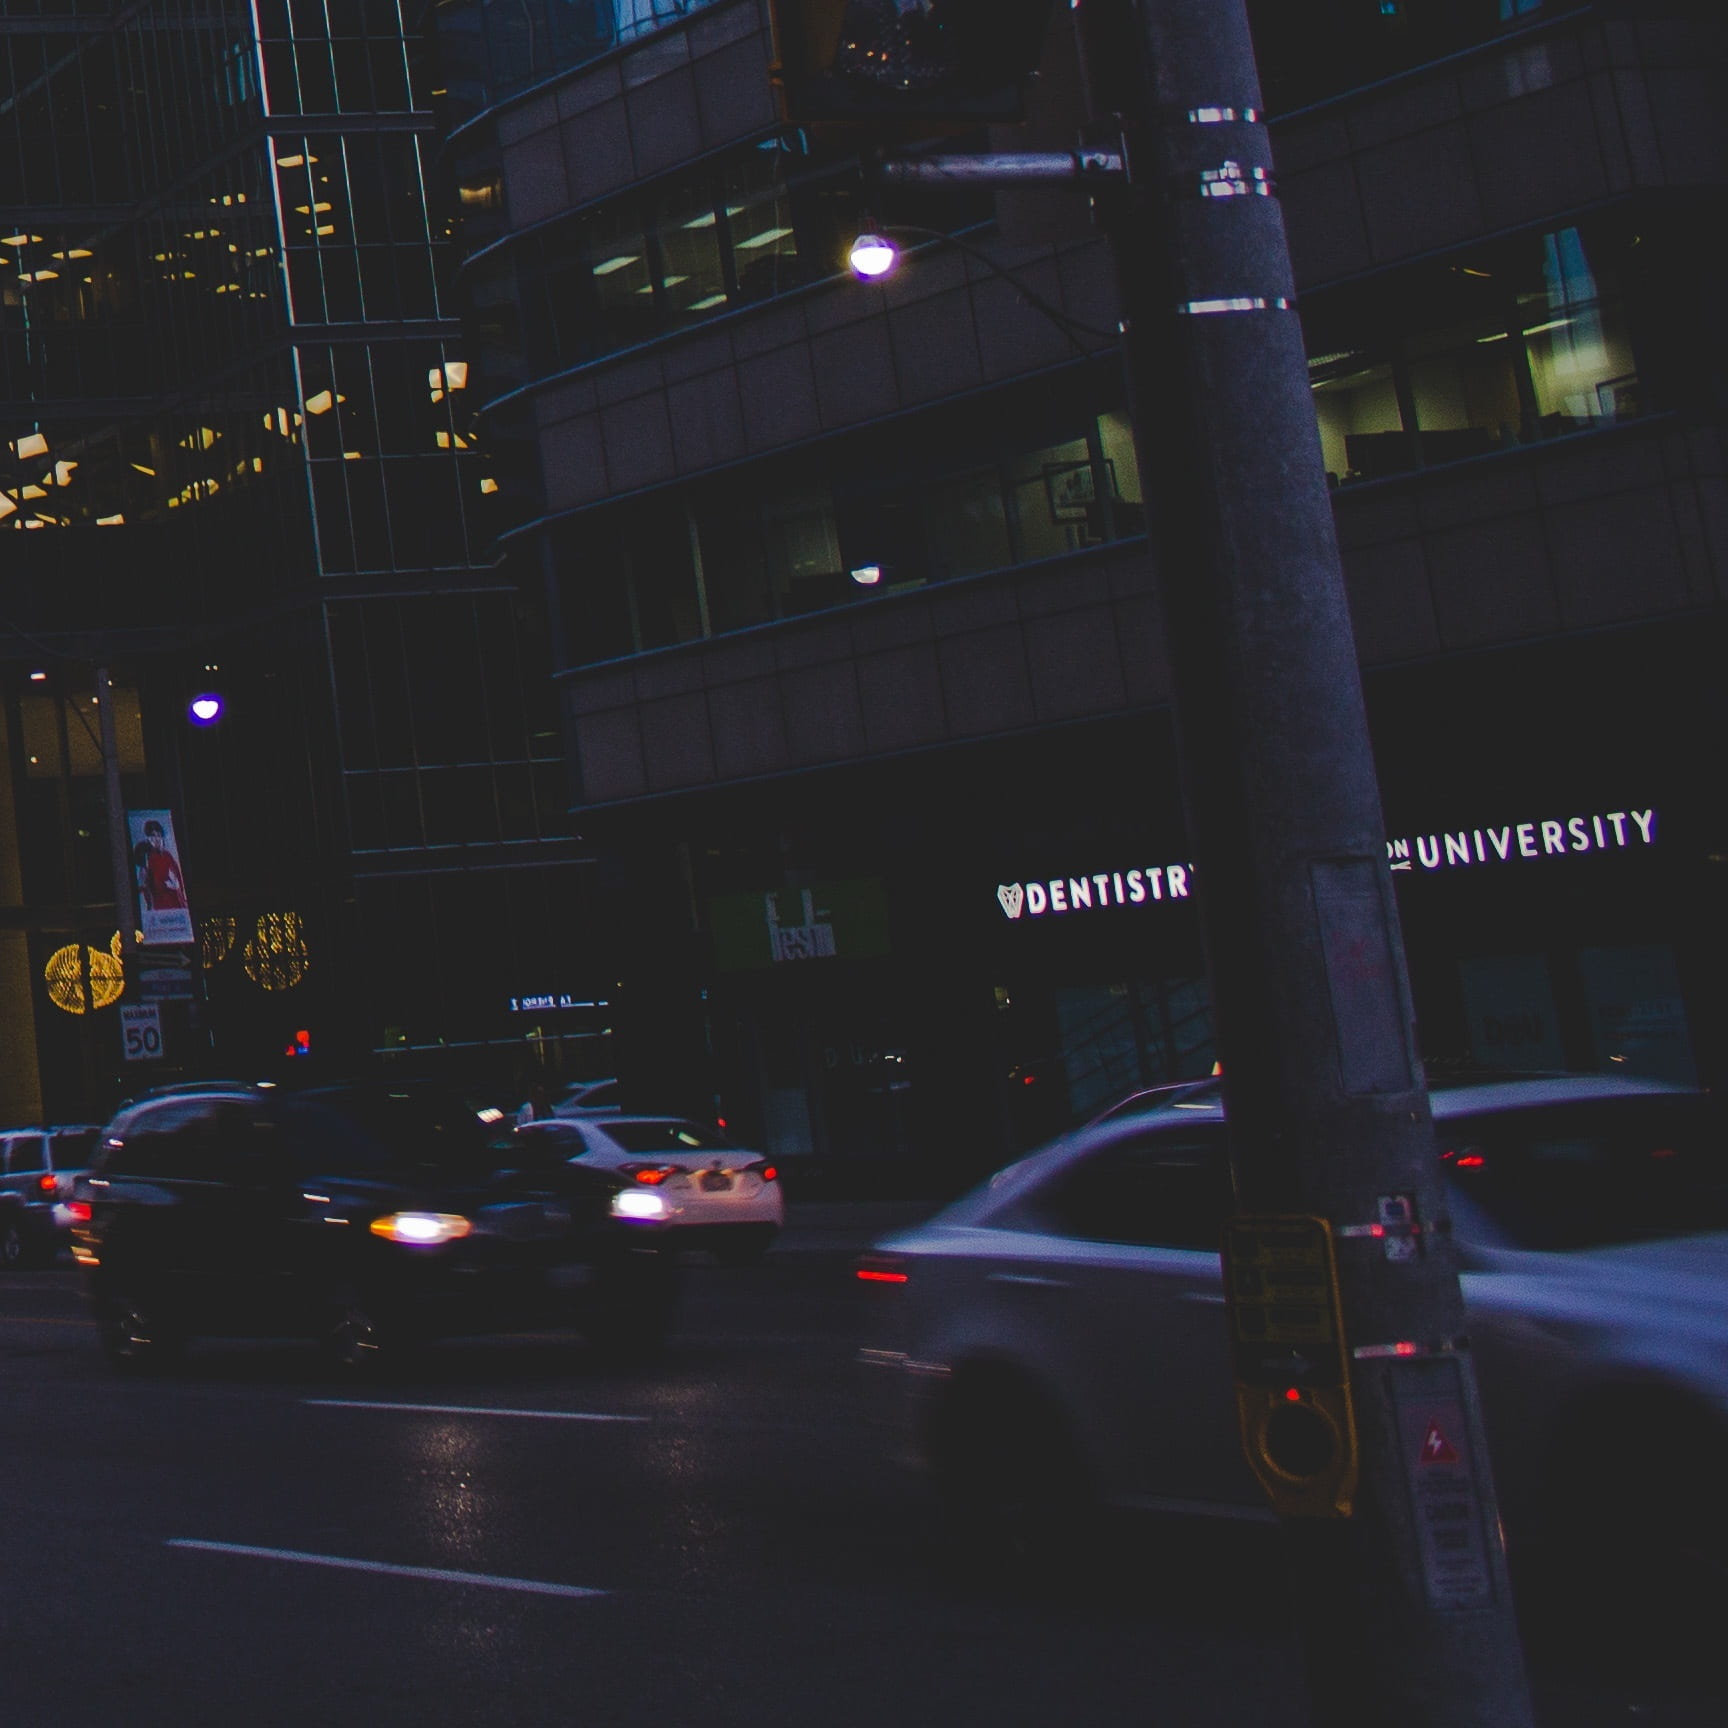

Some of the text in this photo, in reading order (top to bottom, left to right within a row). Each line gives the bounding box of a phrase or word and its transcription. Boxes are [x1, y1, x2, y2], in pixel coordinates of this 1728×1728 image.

[1026, 863, 1195, 916] DENTISTR
[1416, 809, 1656, 869] UNIVERSITY
[126, 1026, 159, 1055] 50
